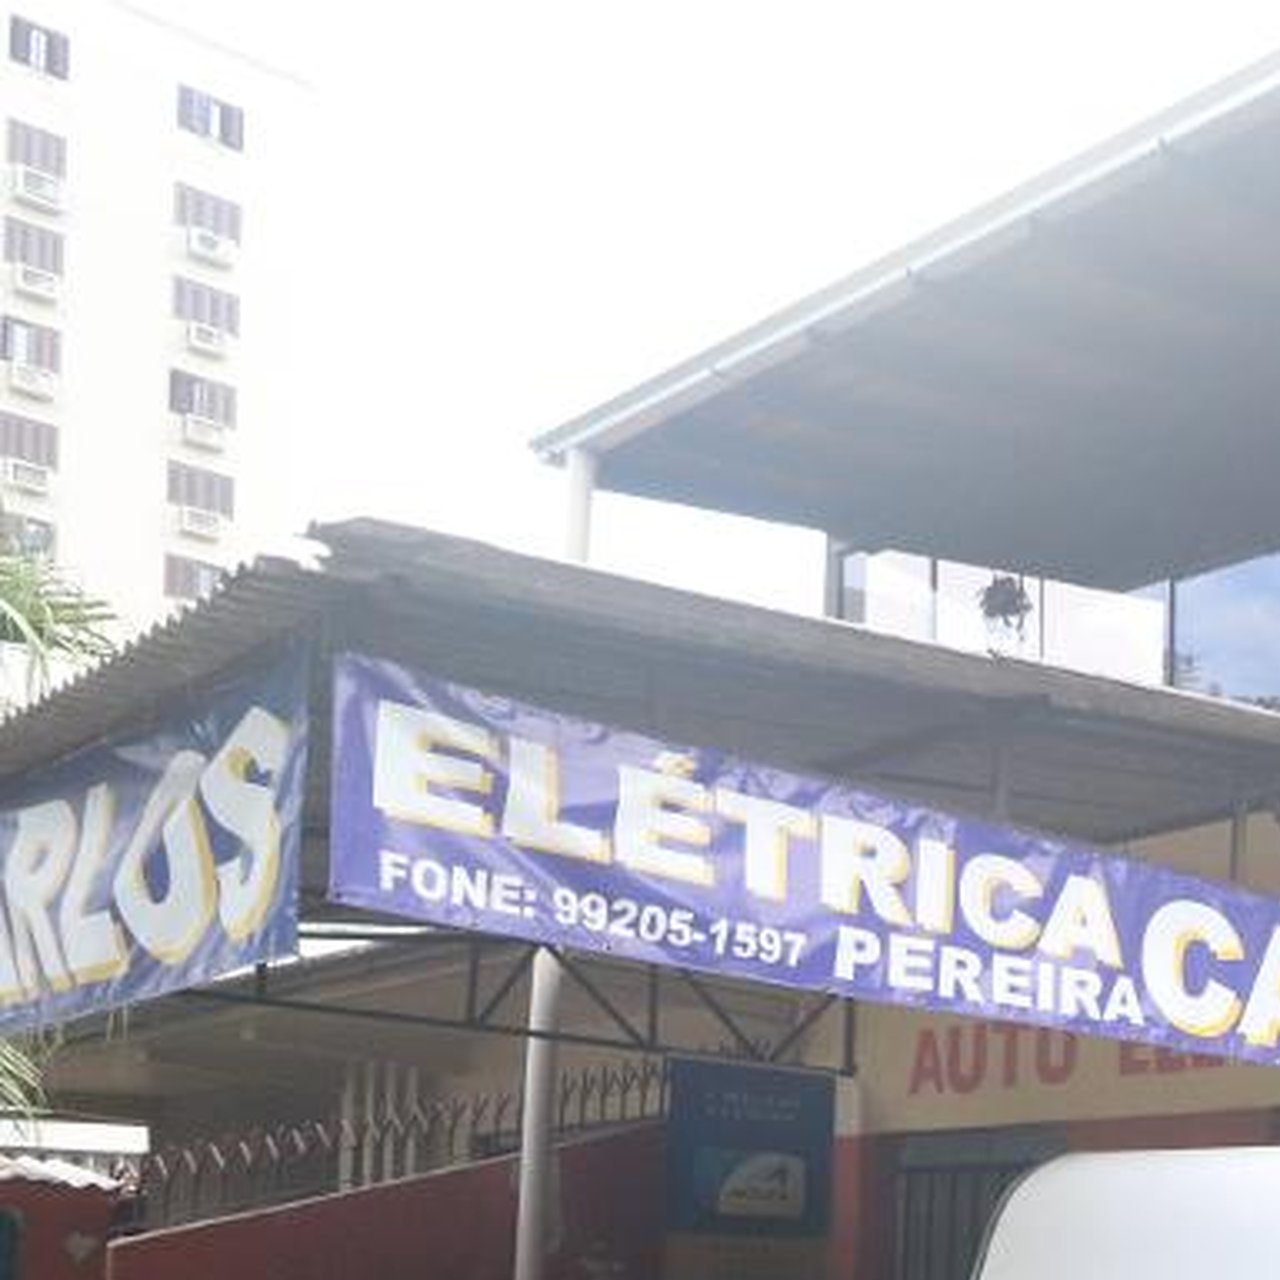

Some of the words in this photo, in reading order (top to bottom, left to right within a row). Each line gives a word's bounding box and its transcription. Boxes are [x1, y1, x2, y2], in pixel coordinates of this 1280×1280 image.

[0, 705, 291, 1003] RLOS
[372, 700, 1124, 971] ELÉTRICA
[378, 851, 538, 919] FONE:
[552, 888, 807, 970] 99205-1597
[833, 924, 1145, 1027] PEREIRA
[908, 1022, 1078, 1096] AUTO
